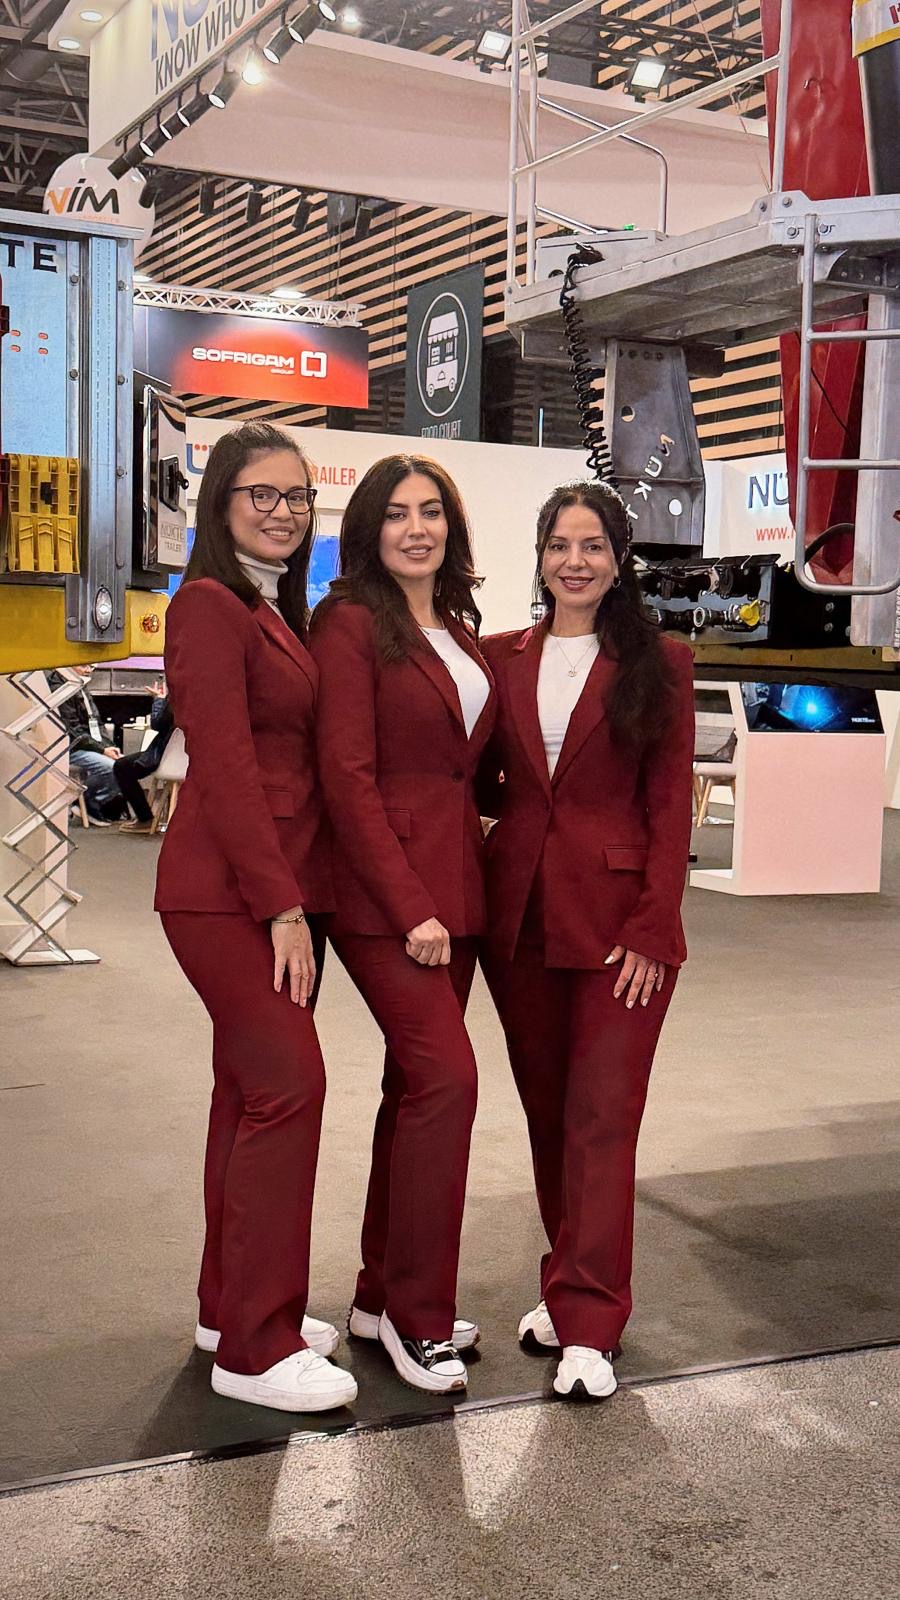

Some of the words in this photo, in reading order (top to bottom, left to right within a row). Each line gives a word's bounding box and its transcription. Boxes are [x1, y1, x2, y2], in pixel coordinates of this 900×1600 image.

[155, 22, 201, 95] KNOW
[205, 0, 246, 52] WHO
[191, 347, 295, 368] SOFRIGAM
[421, 425, 438, 439] FOOD
[439, 419, 462, 440] COURT
[311, 464, 357, 486] RAILER
